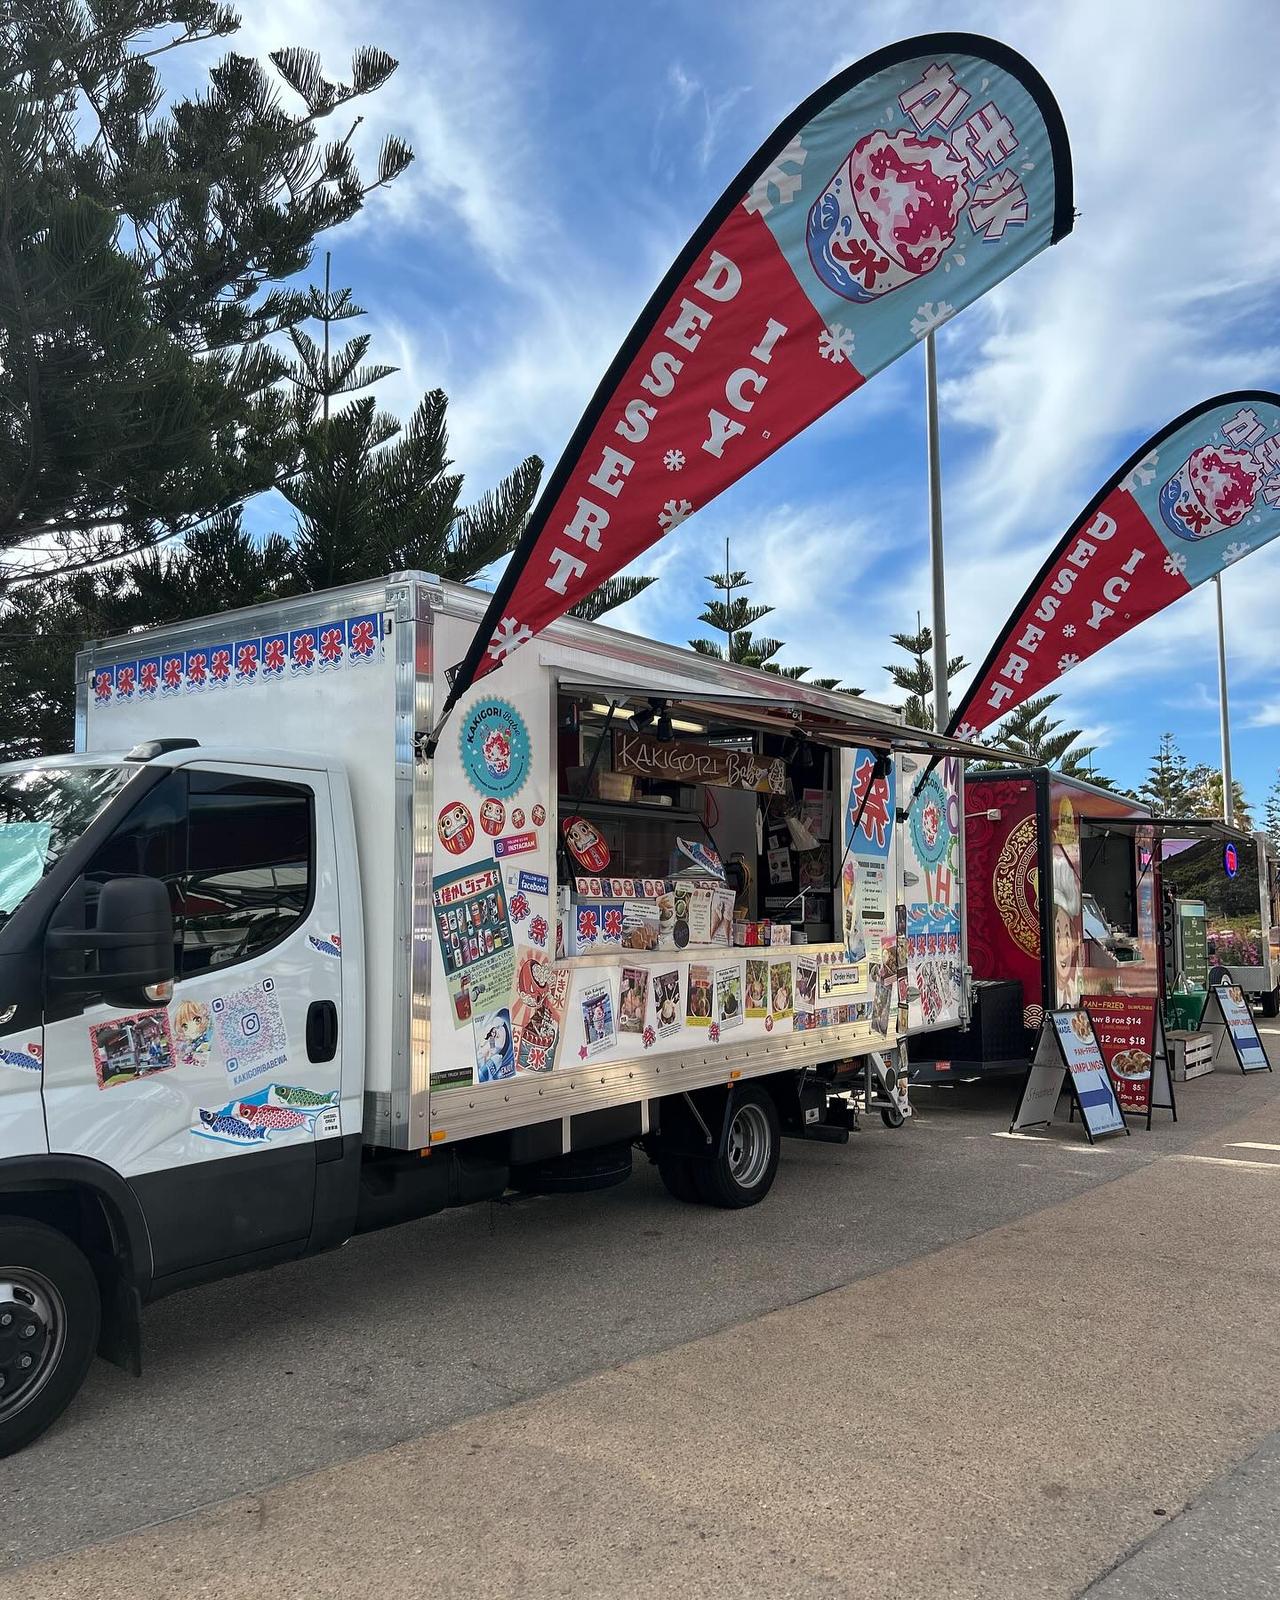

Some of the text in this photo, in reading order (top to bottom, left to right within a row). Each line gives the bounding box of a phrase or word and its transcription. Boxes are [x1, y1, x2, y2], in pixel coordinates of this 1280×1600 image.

[700, 317, 789, 459] ICY
[543, 250, 743, 596] DESSERT
[1086, 548, 1145, 630] ICY
[987, 511, 1117, 710] DESSERT
[467, 707, 502, 743] KAKIGORI
[618, 734, 719, 776] KAKIGORI
[507, 840, 536, 851] INSTAGRAM
[521, 879, 547, 893] facebook
[833, 972, 856, 981] Order Here
[1083, 1000, 1125, 1010] PAN-FRIED
[1105, 1015, 1110, 1024] 8
[1126, 1016, 1141, 1025] $14
[1100, 1035, 1111, 1043] 12
[1113, 1036, 1125, 1044] FOR
[1129, 1036, 1146, 1046] $18
[233, 1054, 288, 1086] KAKIGORIBABEWA
